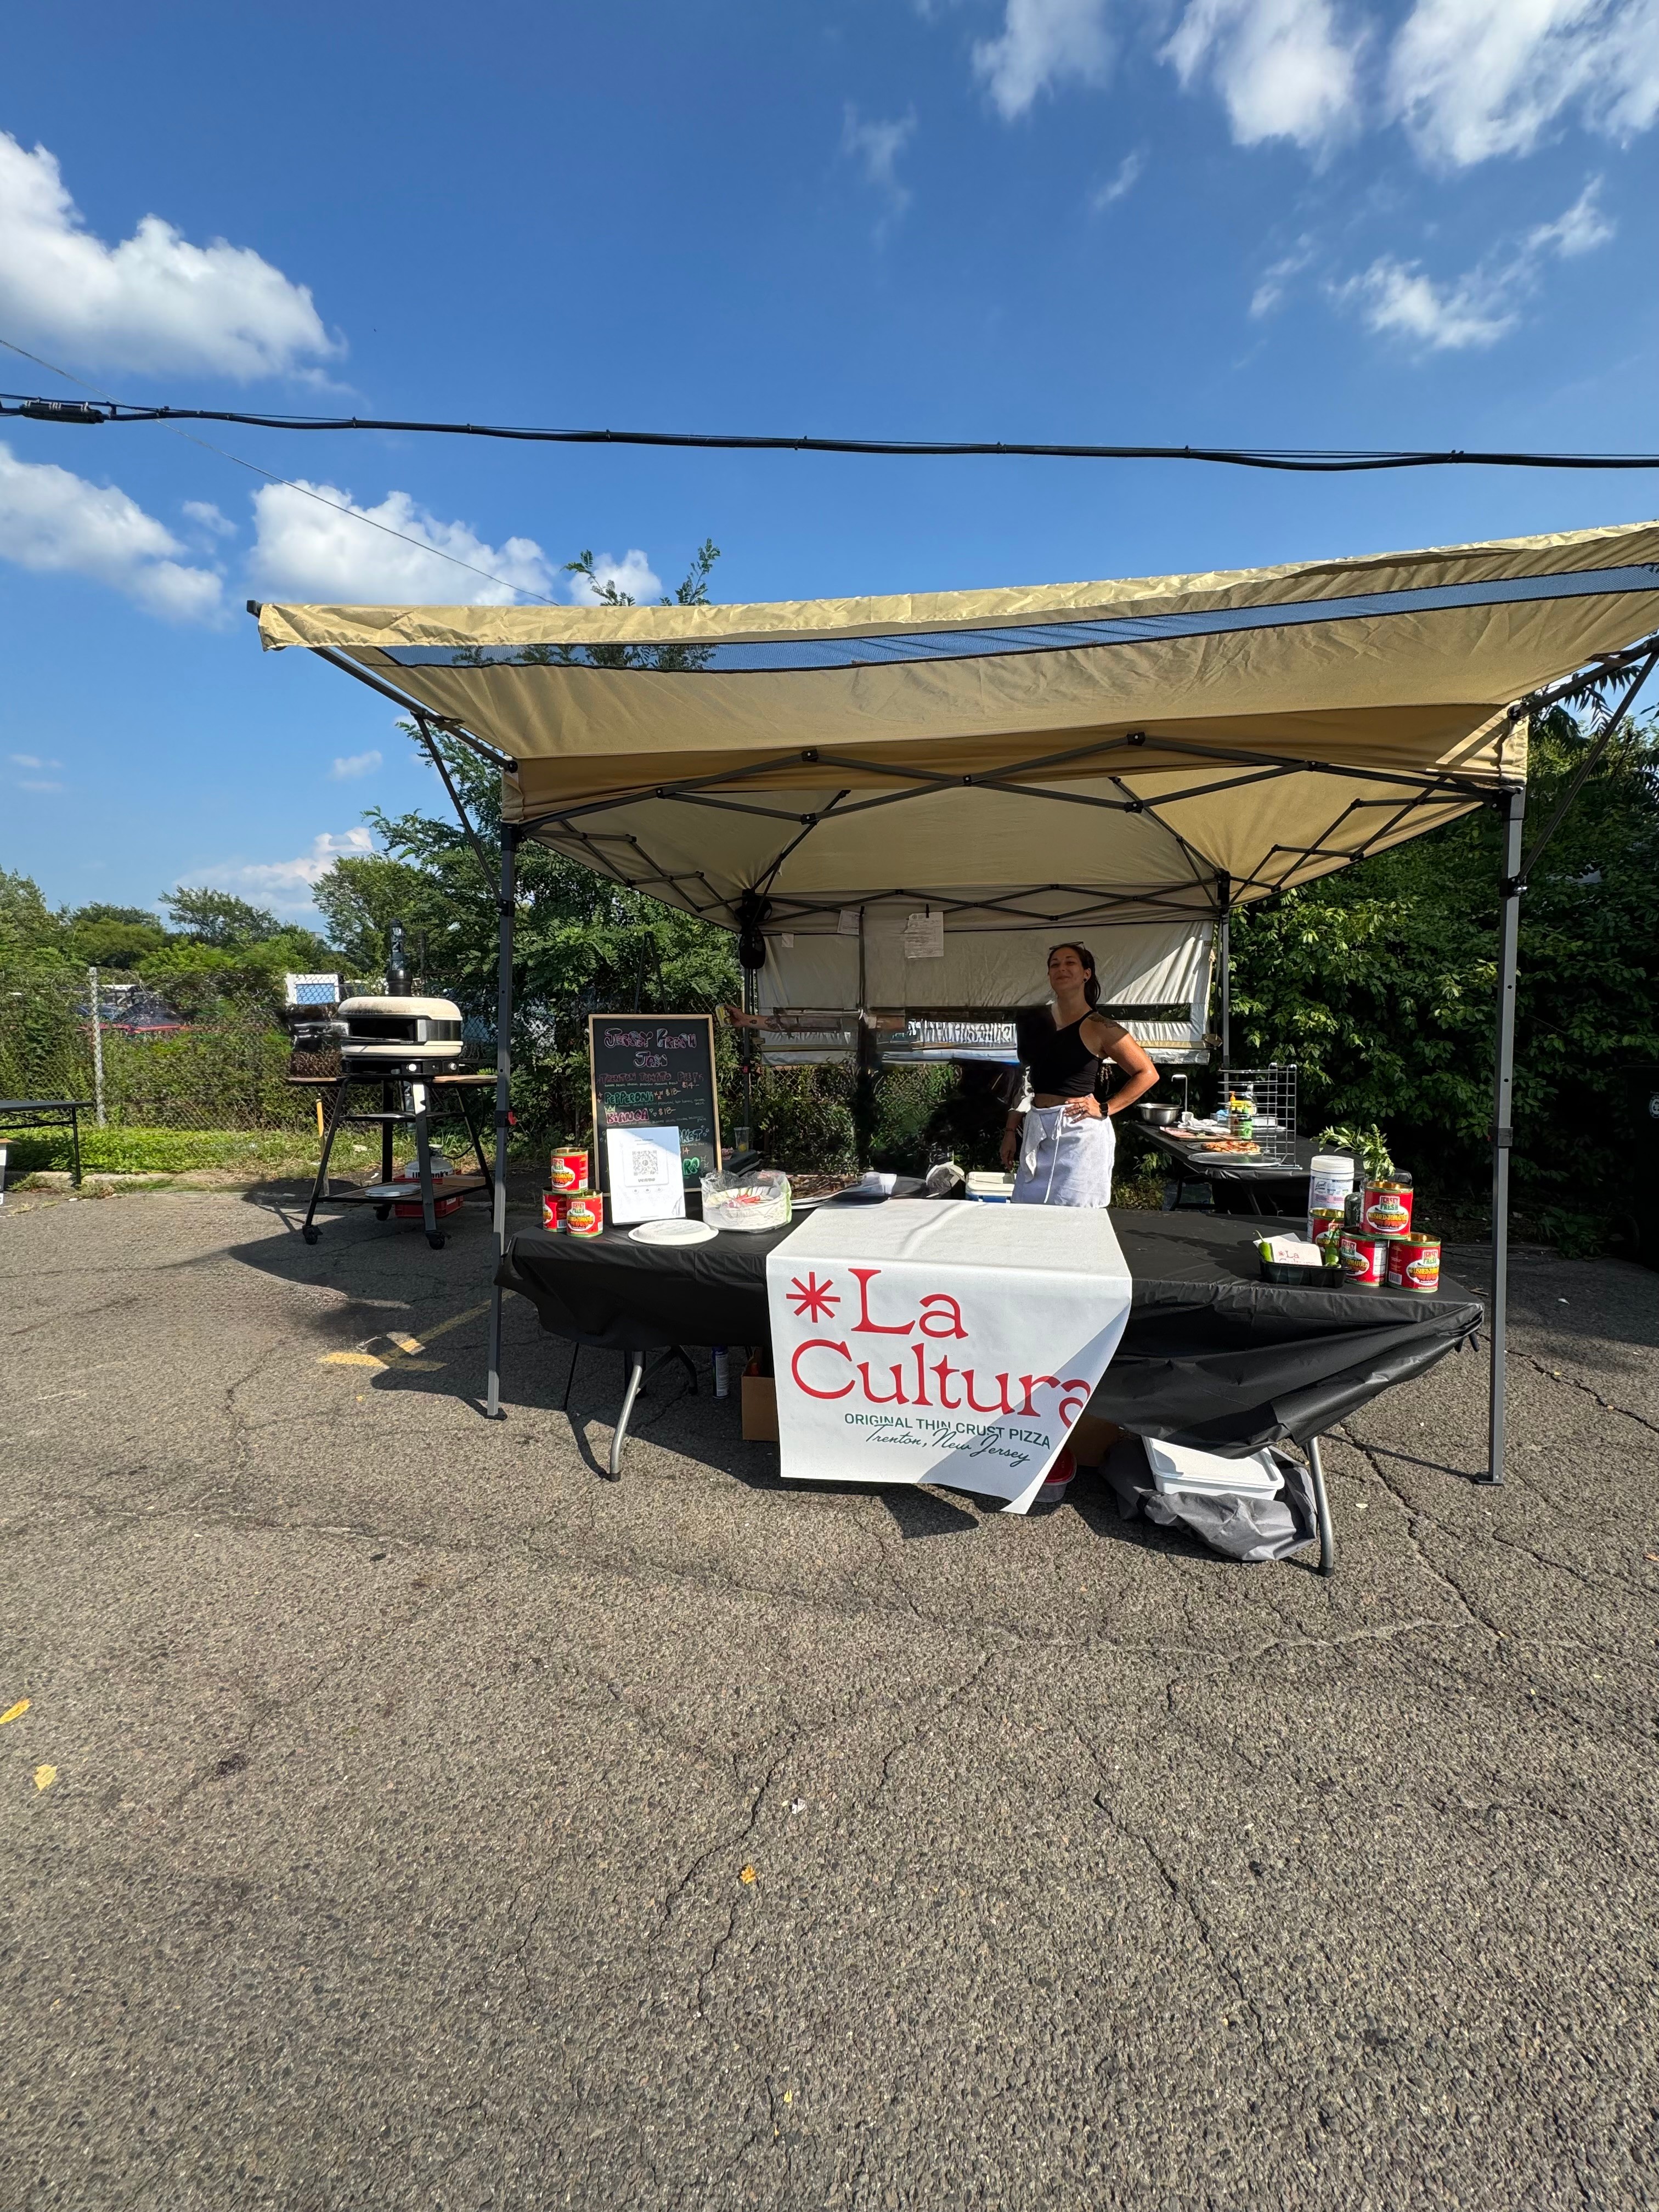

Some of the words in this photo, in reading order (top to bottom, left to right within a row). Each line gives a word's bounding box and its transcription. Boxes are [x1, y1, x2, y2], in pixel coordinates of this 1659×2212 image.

[848, 1268, 968, 1339] La
[791, 1338, 1091, 1429] Cultura
[844, 1413, 913, 1429] ORIGINAL
[916, 1418, 951, 1431] THIN
[956, 1422, 1005, 1438] CRUST
[1008, 1429, 1051, 1450] PIZZA
[866, 1424, 927, 1449] Trenton,
[932, 1427, 973, 1451] New
[969, 1434, 1031, 1468] Jersey
